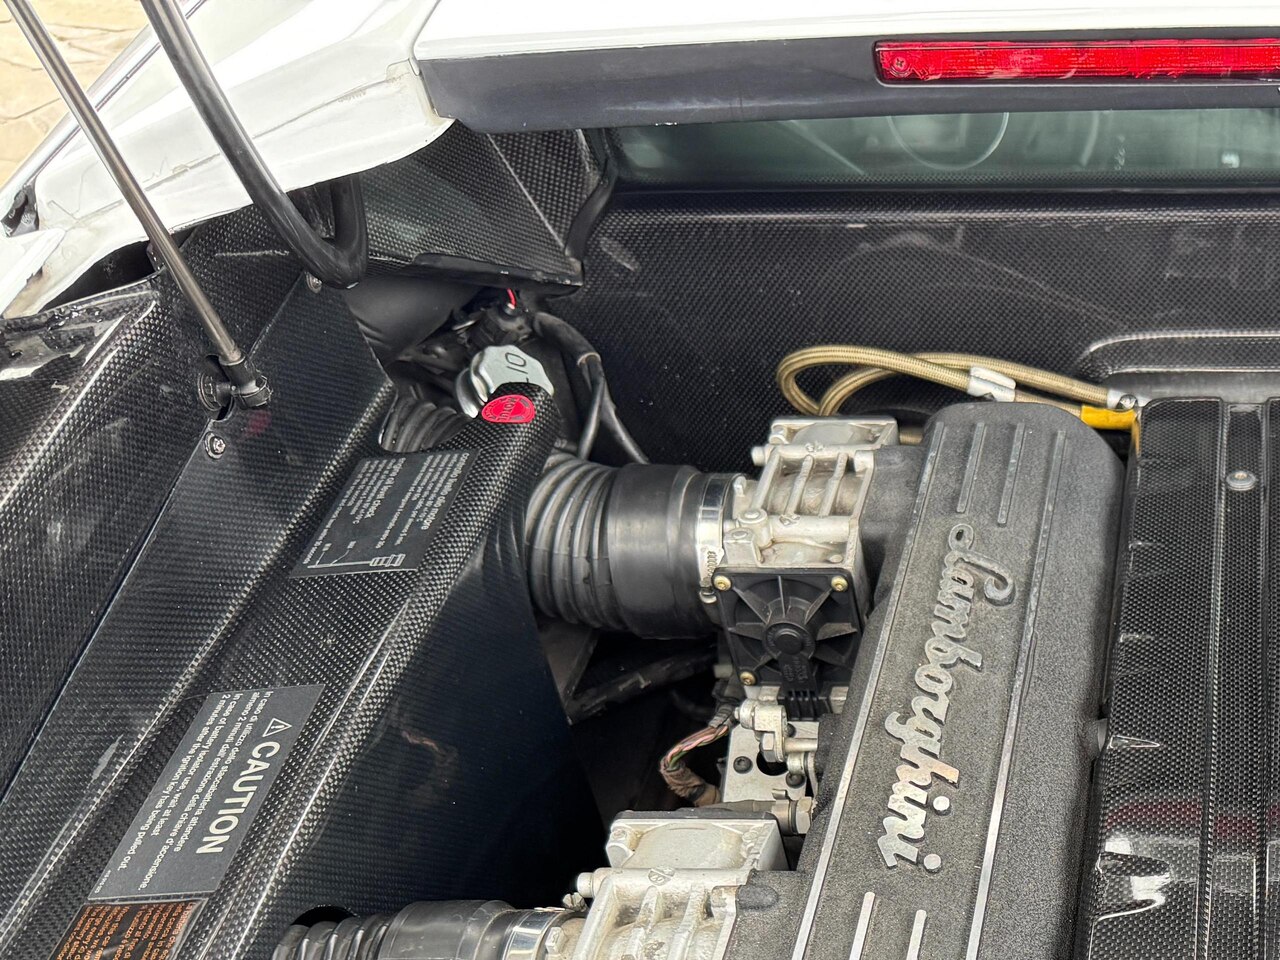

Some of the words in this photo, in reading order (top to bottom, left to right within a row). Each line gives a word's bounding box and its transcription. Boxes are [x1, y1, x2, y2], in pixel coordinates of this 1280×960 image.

[447, 452, 473, 477] controllo
[374, 485, 392, 499] level
[437, 477, 459, 495] livello
[363, 499, 383, 518] check
[431, 495, 449, 507] olio
[418, 507, 442, 530] motore
[240, 691, 261, 715] almeno
[252, 698, 268, 713] caso
[877, 523, 1015, 872] Lamborghini
[204, 699, 227, 725] minutes
[222, 701, 237, 715] case
[194, 726, 211, 742] after
[200, 725, 224, 749] battery
[224, 722, 243, 742] minuti
[234, 723, 255, 745] utilizzo
[187, 743, 201, 754] the
[223, 747, 240, 763] dello
[170, 755, 194, 780] ignition
[194, 743, 231, 792] dall'estrazione
[161, 781, 178, 794] key
[175, 776, 192, 791] use,
[193, 765, 230, 815] staccabatteria
[154, 795, 169, 808] has
[166, 793, 182, 807] wait
[183, 794, 201, 811] della
[194, 741, 283, 853] CAUTION
[139, 810, 160, 830] being
[149, 818, 168, 835] least
[168, 812, 190, 836] chiave
[125, 831, 147, 854] pulled
[172, 816, 200, 851] attendere
[116, 855, 132, 870] out.
[137, 838, 176, 890] d'accensione.
[170, 910, 192, 934] batteria
[164, 936, 177, 948] che
